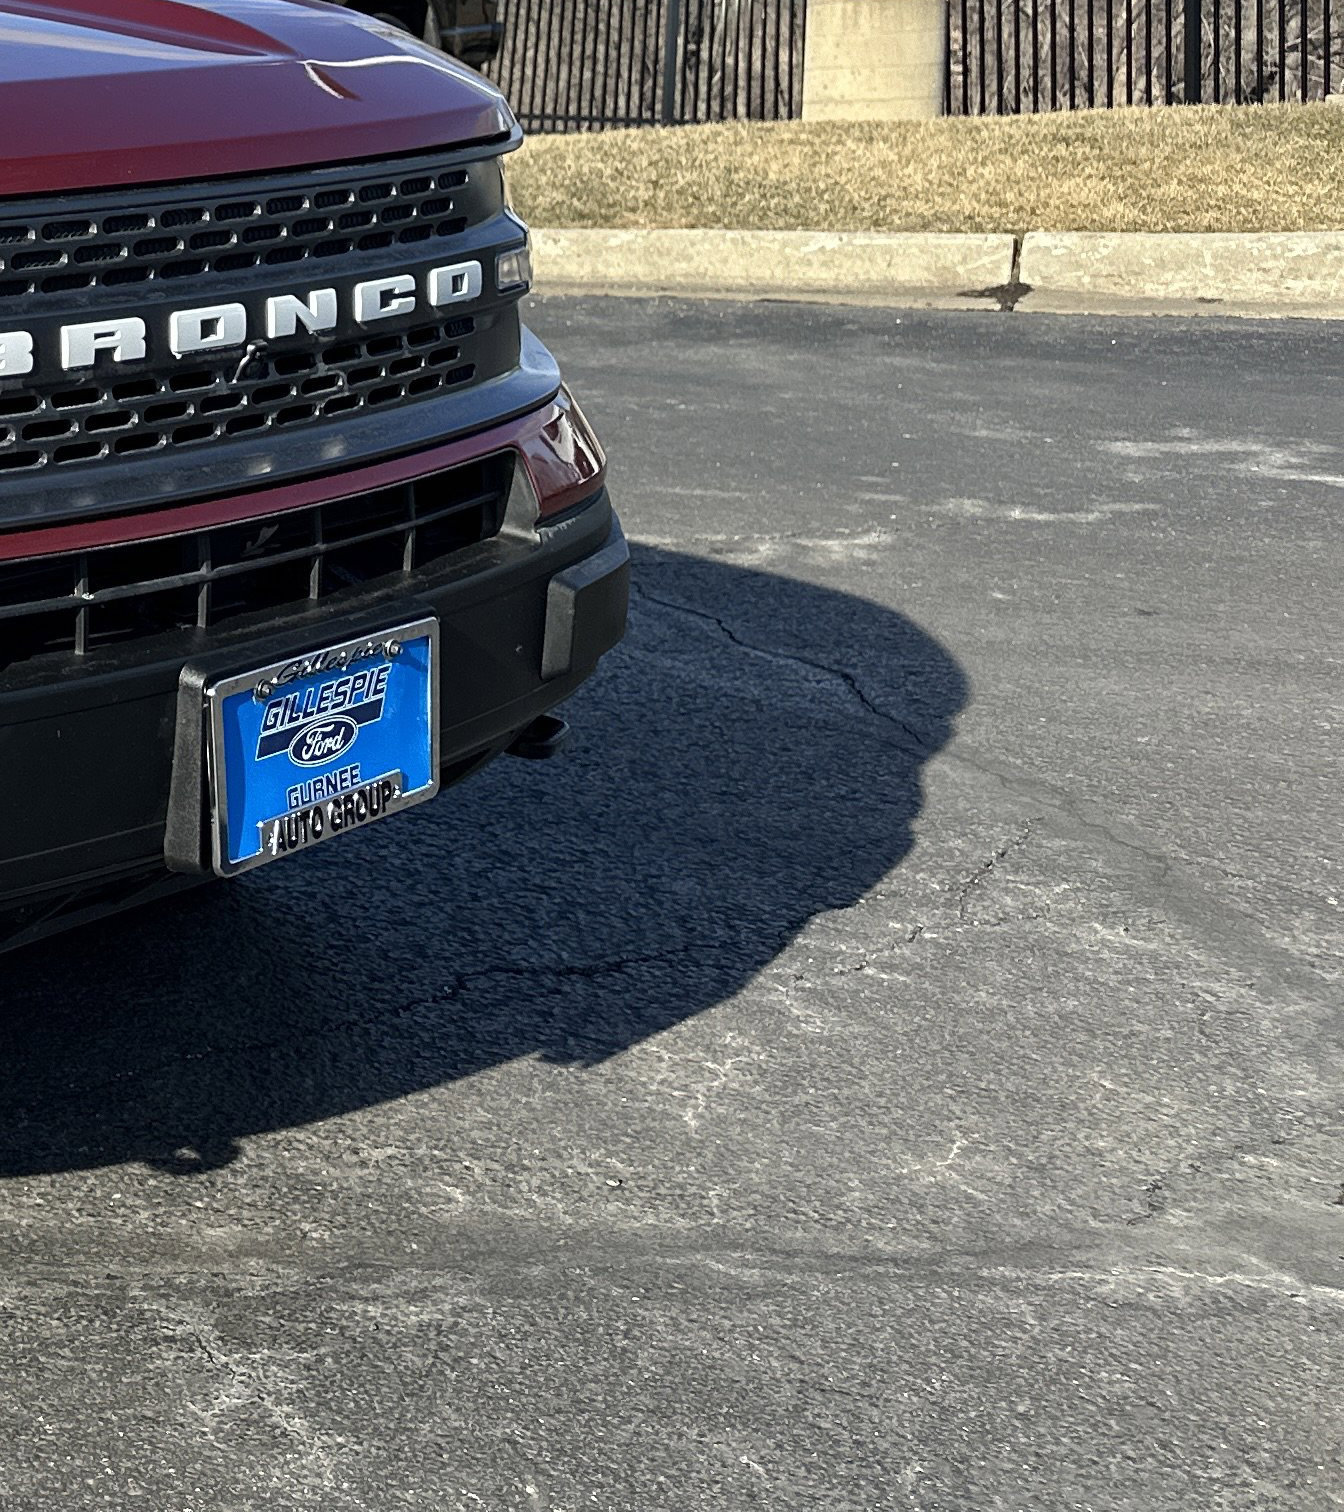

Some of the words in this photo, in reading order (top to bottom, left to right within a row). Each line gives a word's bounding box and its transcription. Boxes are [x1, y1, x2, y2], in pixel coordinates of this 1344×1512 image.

[261, 662, 393, 733] GILLESPIE
[301, 723, 345, 761] Ford
[286, 763, 362, 810] GURNEE
[267, 804, 324, 856] AUTO
[328, 780, 392, 833] GROUP
